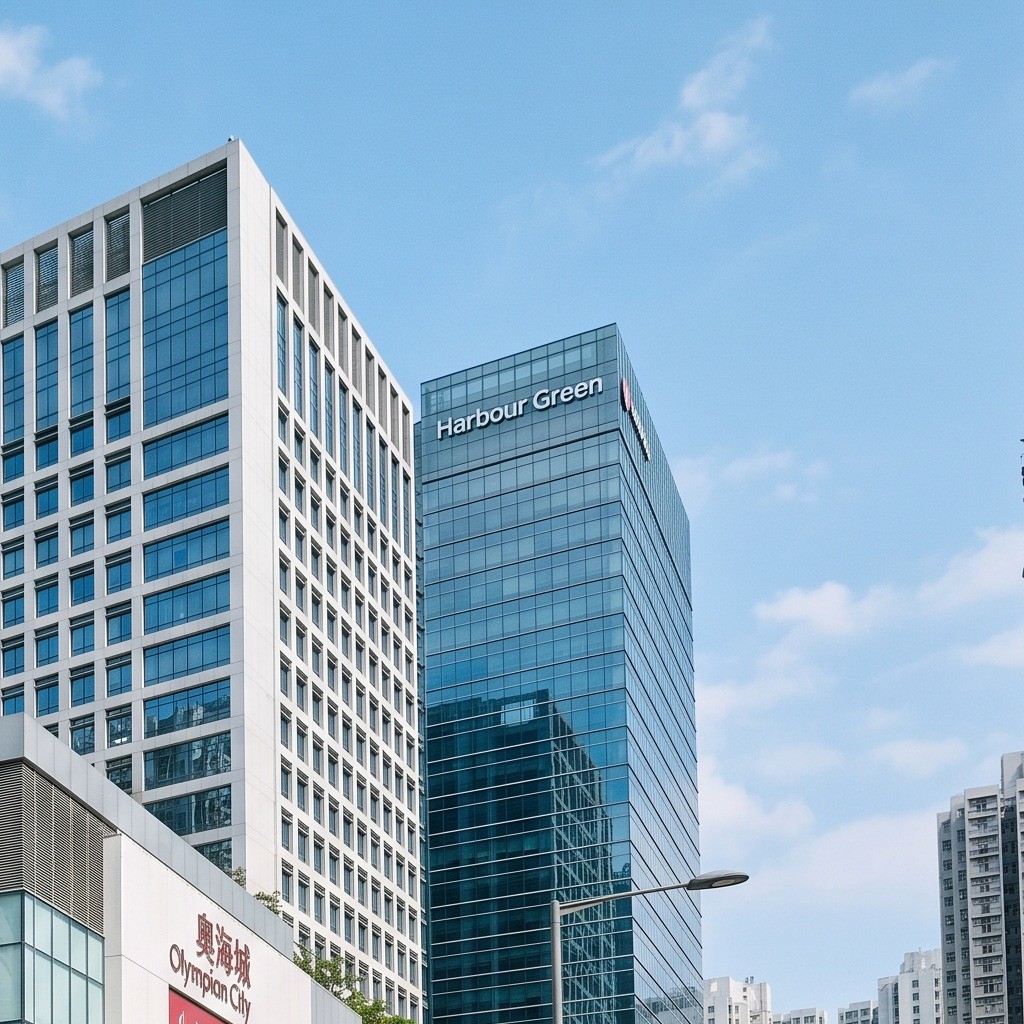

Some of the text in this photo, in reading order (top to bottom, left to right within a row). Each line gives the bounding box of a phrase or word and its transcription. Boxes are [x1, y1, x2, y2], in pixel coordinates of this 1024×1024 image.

[437, 377, 603, 440] Harbour Green
[169, 944, 228, 1004] Olympian
